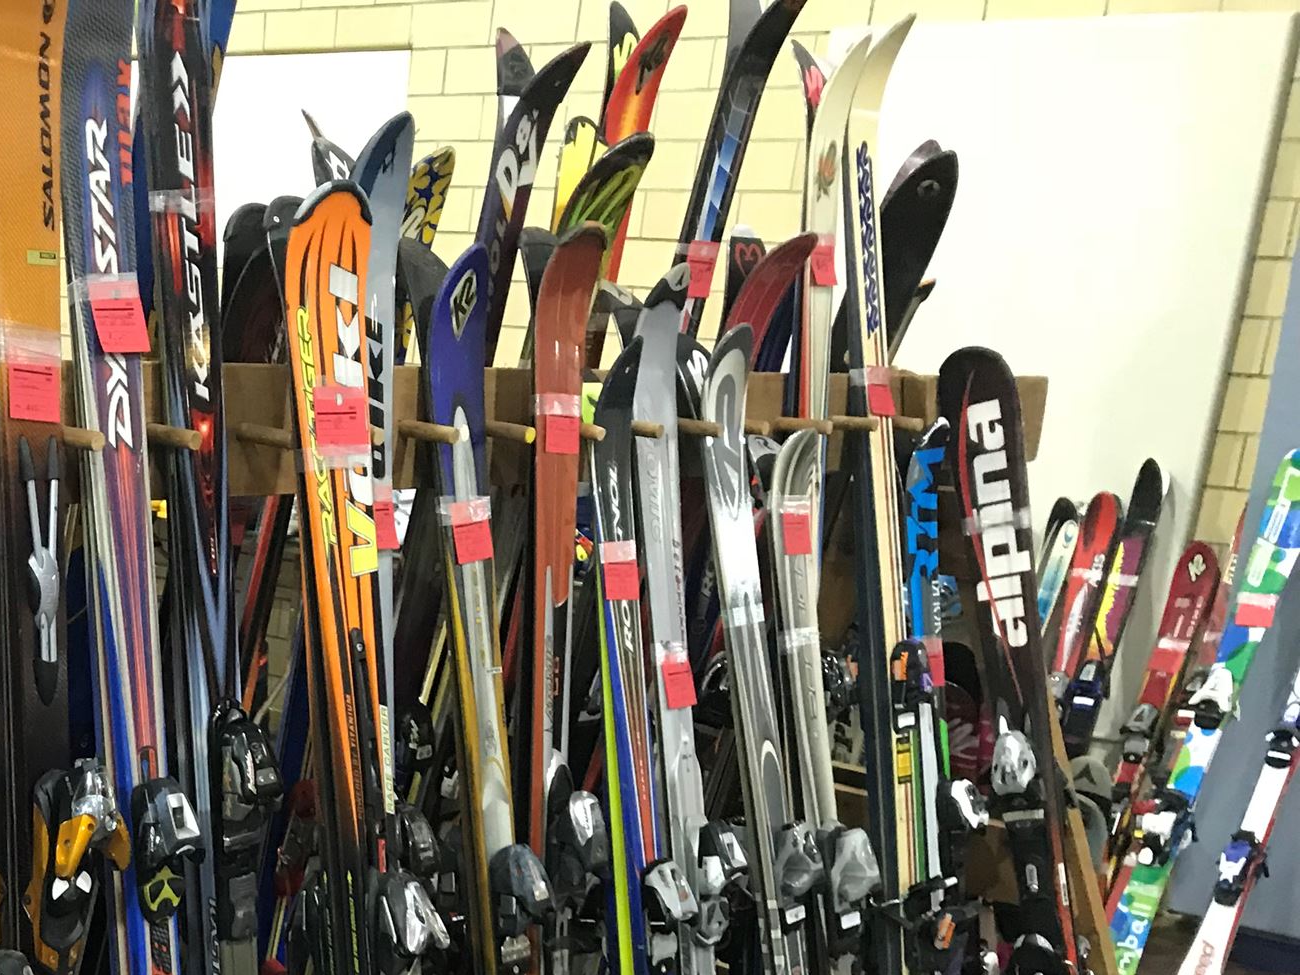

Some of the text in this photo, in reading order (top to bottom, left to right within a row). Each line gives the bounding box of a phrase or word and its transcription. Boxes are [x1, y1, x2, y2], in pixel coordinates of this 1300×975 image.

[39, 31, 55, 232] SALOMON
[84, 117, 134, 450] DYSTAR
[966, 399, 1032, 648] alpina
